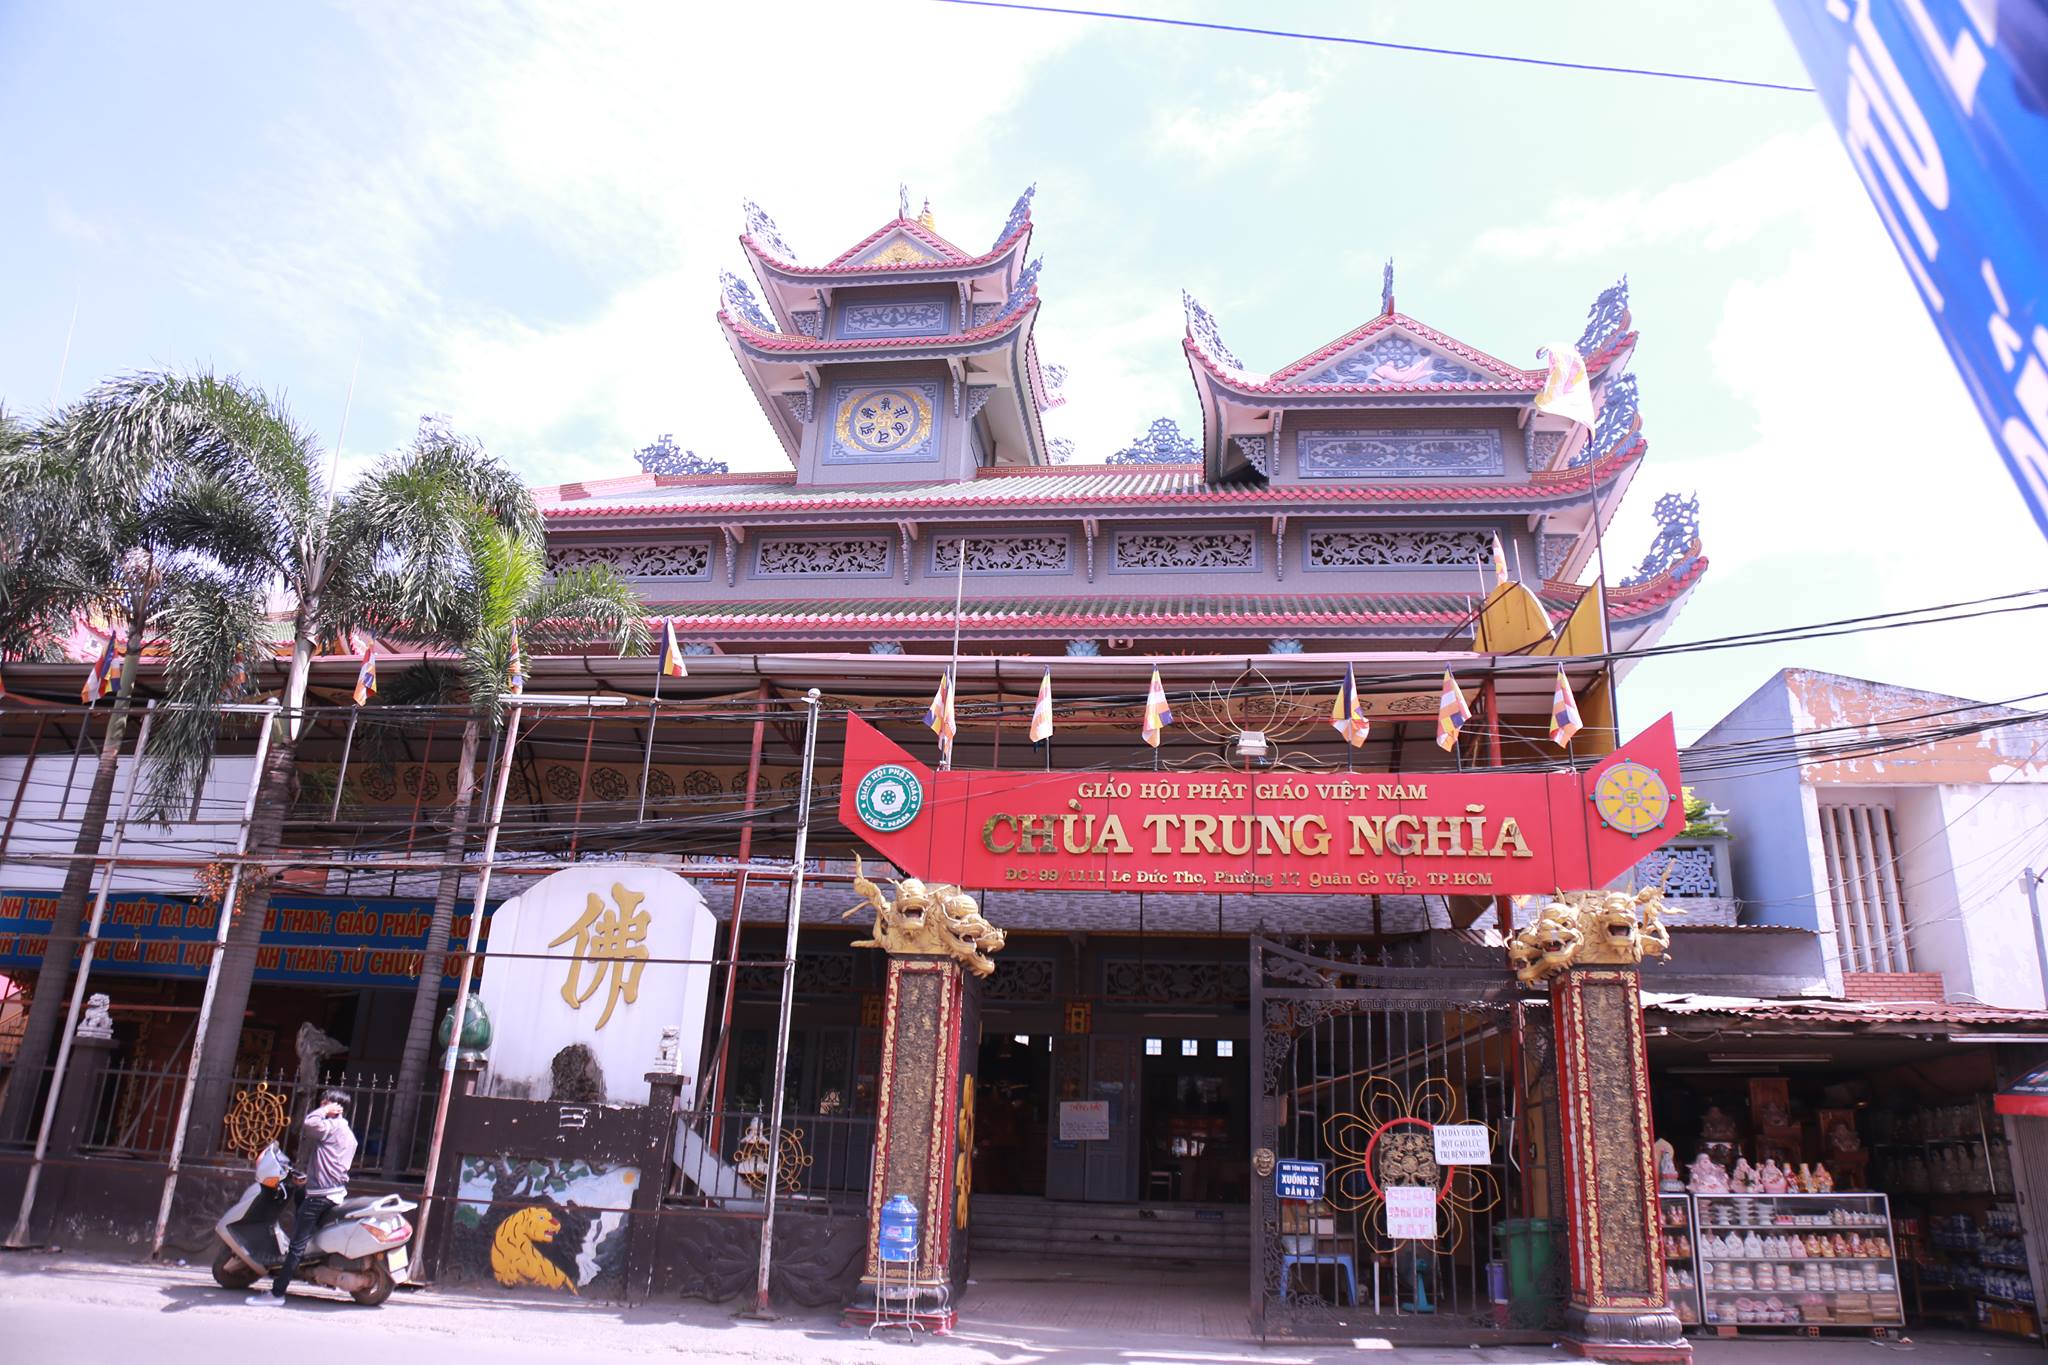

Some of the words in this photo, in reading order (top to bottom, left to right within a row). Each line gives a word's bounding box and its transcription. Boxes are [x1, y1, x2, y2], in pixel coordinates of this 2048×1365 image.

[1078, 777, 1132, 799] GIÁO
[1140, 779, 1180, 804] HỘI
[1187, 779, 1248, 804] PHẬT
[1256, 778, 1309, 800] GIÁO
[1316, 780, 1370, 806] VIỆT
[1378, 784, 1428, 800] NAM
[982, 798, 1134, 855] CHÙA
[1142, 813, 1333, 857] TRUNG
[1348, 803, 1534, 858] NGHĨA
[1136, 868, 1168, 883] Đức
[1357, 869, 1379, 885] Gò
[1426, 872, 1493, 885] TP.HCM
[26, 898, 58, 921] THA
[111, 897, 158, 928] PHẬT
[159, 904, 181, 927] RA
[281, 908, 331, 934] THAY:
[334, 906, 378, 936] GIÁO
[380, 908, 431, 937] PHÁP
[548, 882, 652, 1031] 佛
[1281, 1172, 1308, 1185] XUỐNG
[1309, 1176, 1320, 1186] XE
